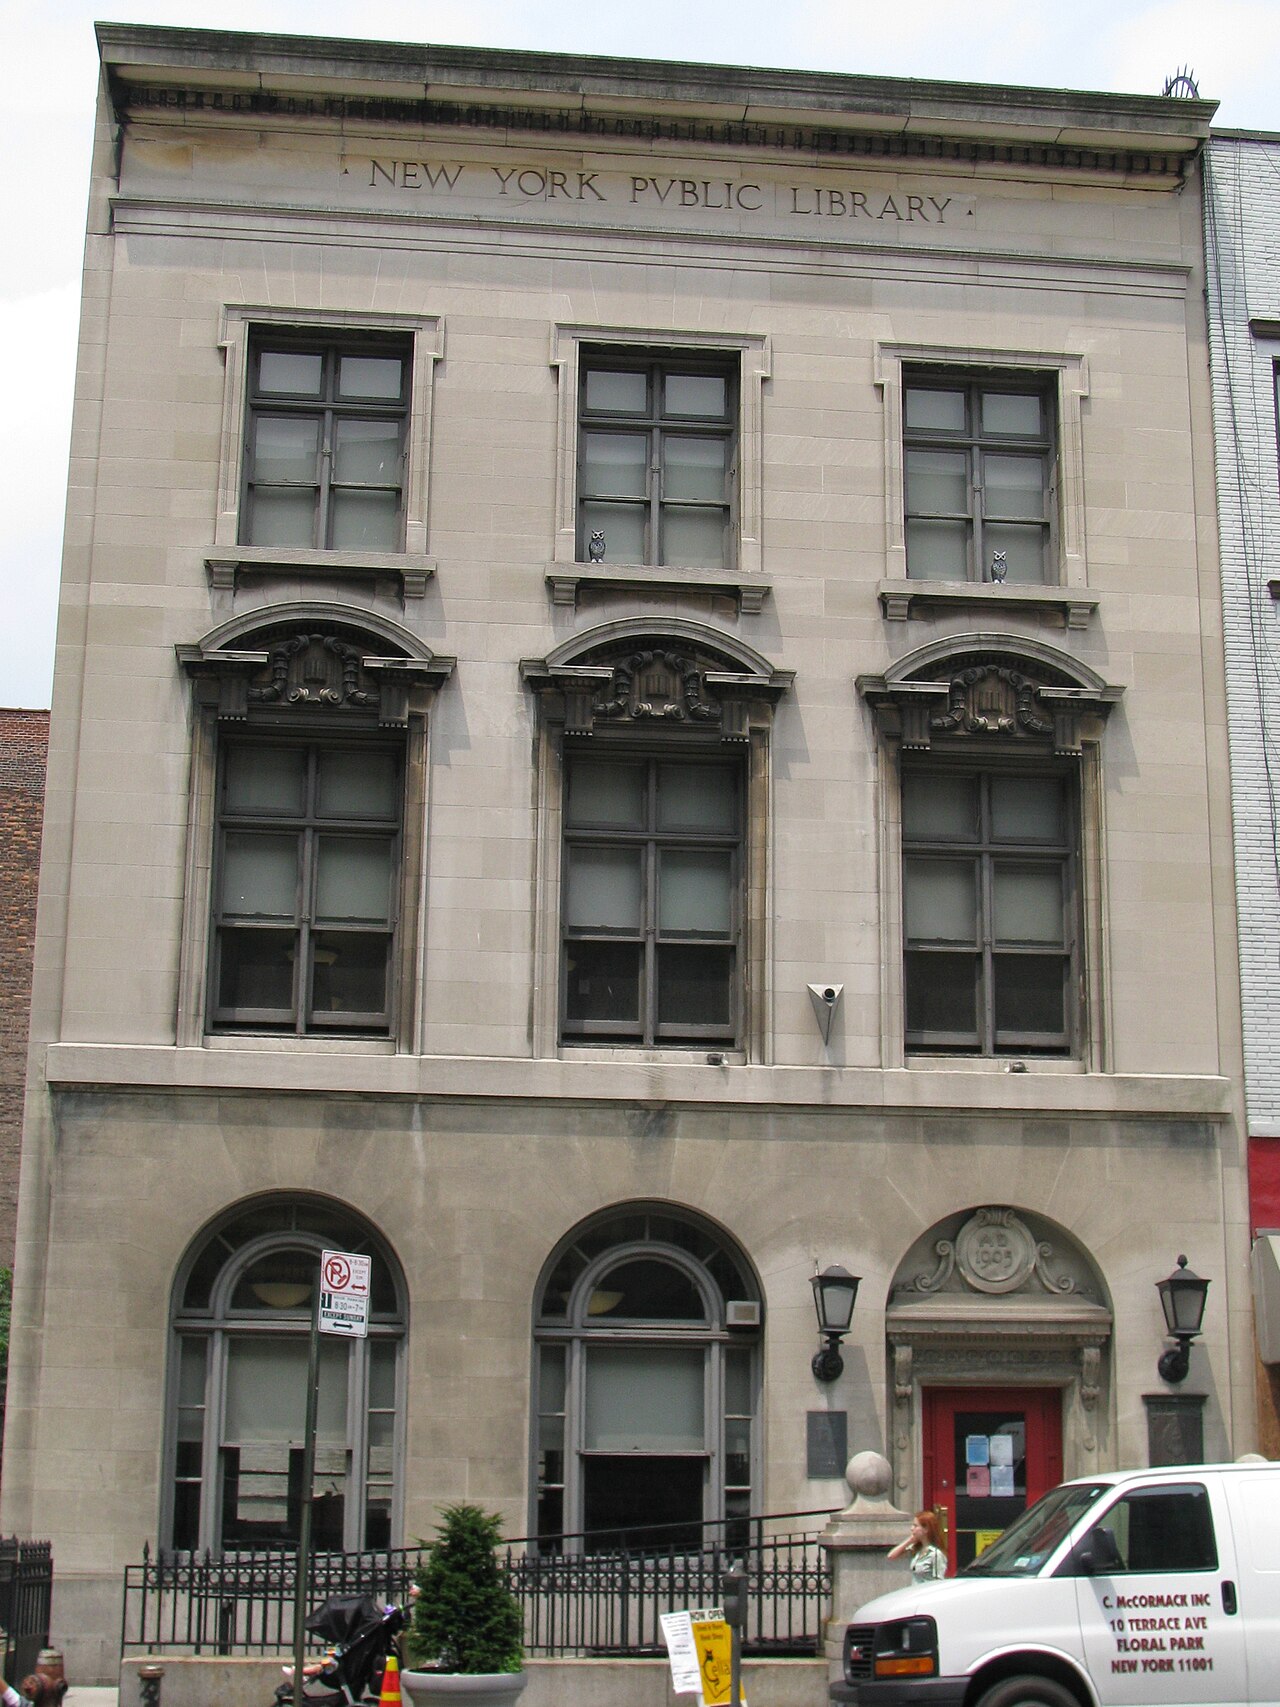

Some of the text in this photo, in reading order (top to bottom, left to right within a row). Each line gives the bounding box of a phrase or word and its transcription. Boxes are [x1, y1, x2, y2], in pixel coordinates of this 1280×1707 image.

[368, 159, 465, 193] NEW
[490, 166, 607, 203] YORK
[789, 187, 953, 224] LIBRARY
[324, 1311, 363, 1321] EXCEPT SUNDAY
[1102, 1593, 1211, 1609] C. McCORMACK INC
[1110, 1616, 1207, 1631] 10 TERRACE AVE
[1117, 1637, 1204, 1652] FLORAL PARK
[1111, 1658, 1213, 1674] NEW YORK 11001
